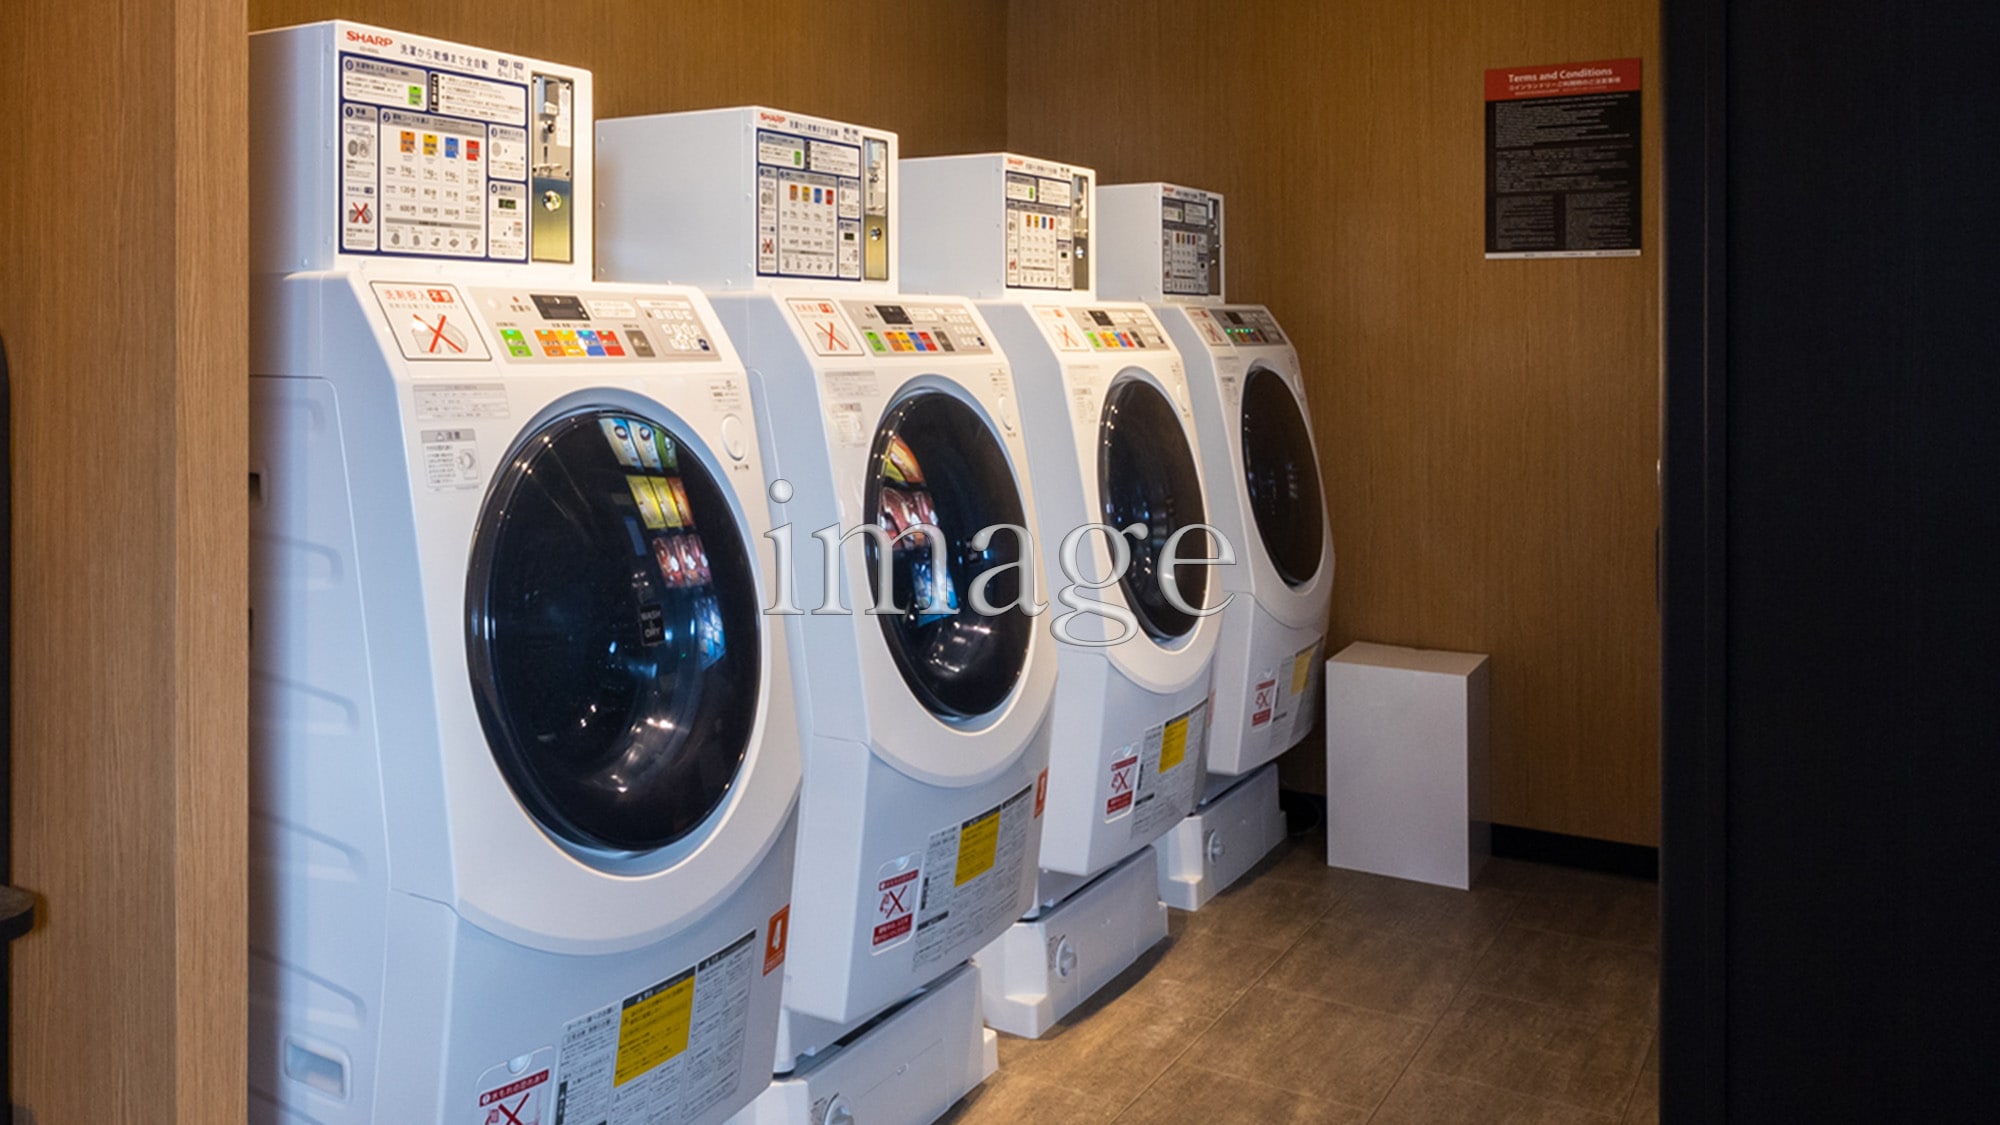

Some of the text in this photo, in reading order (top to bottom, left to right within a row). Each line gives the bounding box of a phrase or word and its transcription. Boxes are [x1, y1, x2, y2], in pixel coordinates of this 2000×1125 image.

[346, 30, 393, 47] SHARP
[400, 43, 489, 69] 洗濯から乾燥まで全自動
[1508, 68, 1613, 83] Terms and Conditions
[771, 918, 783, 950] 4
